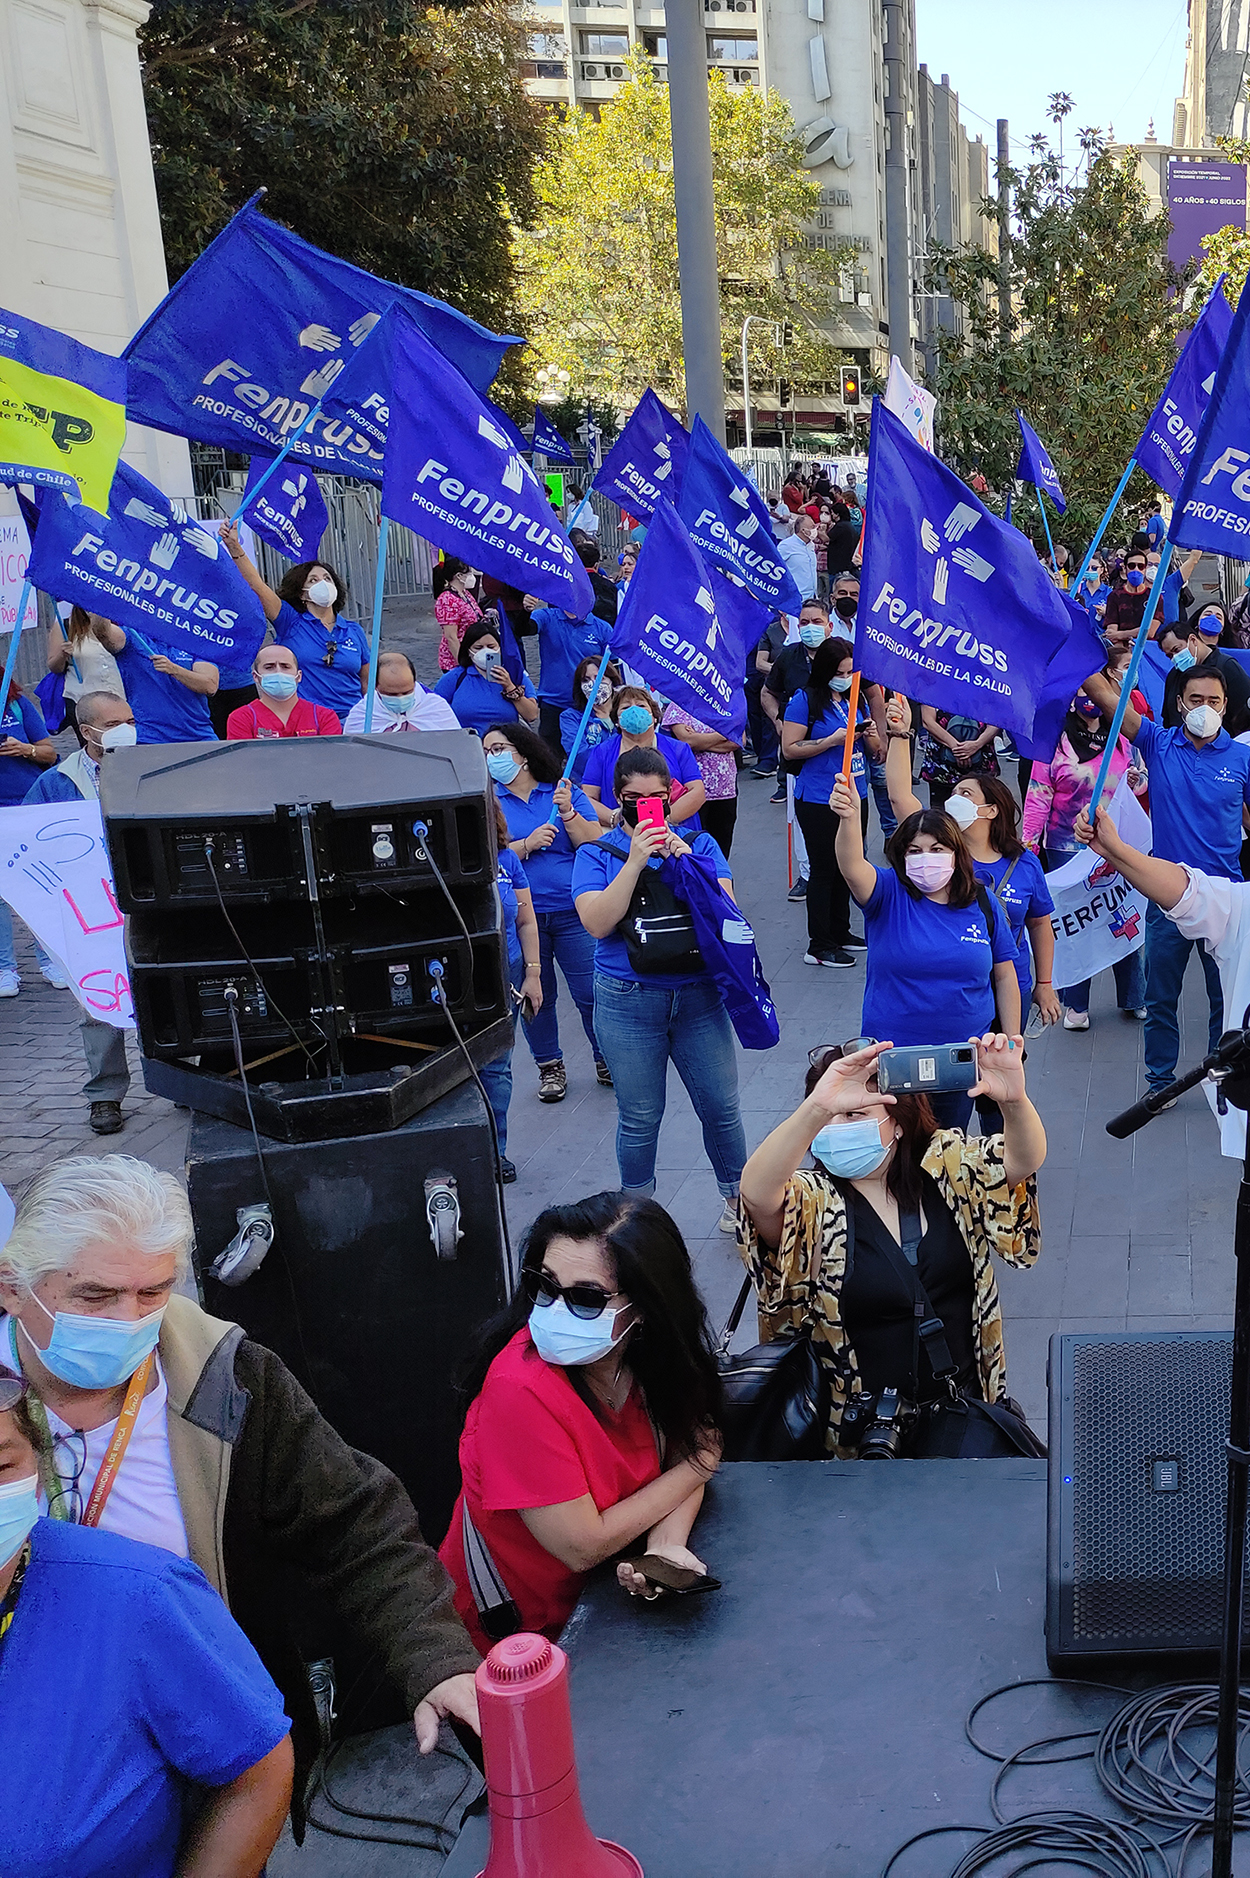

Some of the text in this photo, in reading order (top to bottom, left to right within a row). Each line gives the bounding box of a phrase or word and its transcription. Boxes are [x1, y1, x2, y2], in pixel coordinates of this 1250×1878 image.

[1184, 196, 1204, 204] AÑOS
[17, 470, 32, 479] de
[36, 472, 72, 486] Chile
[416, 458, 574, 564] Fenpruss
[411, 492, 574, 582] PROFESIONALES DE LA SALUD
[64, 561, 234, 648] PROFESIONALES DE LA SALUD
[72, 532, 239, 630] Fenpruss
[754, 577, 780, 596] SALUD
[645, 614, 732, 702] Fenpruss
[871, 582, 1009, 672] Fenpruss
[638, 640, 698, 688] PROFESIONALES
[696, 685, 706, 697] DE
[704, 693, 713, 705] LA
[936, 661, 952, 676] DE
[954, 668, 970, 684] LA
[973, 674, 1012, 696] SALUD
[94, 1466, 114, 1504] MUNICIPAL
[108, 1451, 118, 1463] DE
[113, 1427, 127, 1452] RENCA
[1160, 1468, 1172, 1487] JBL
